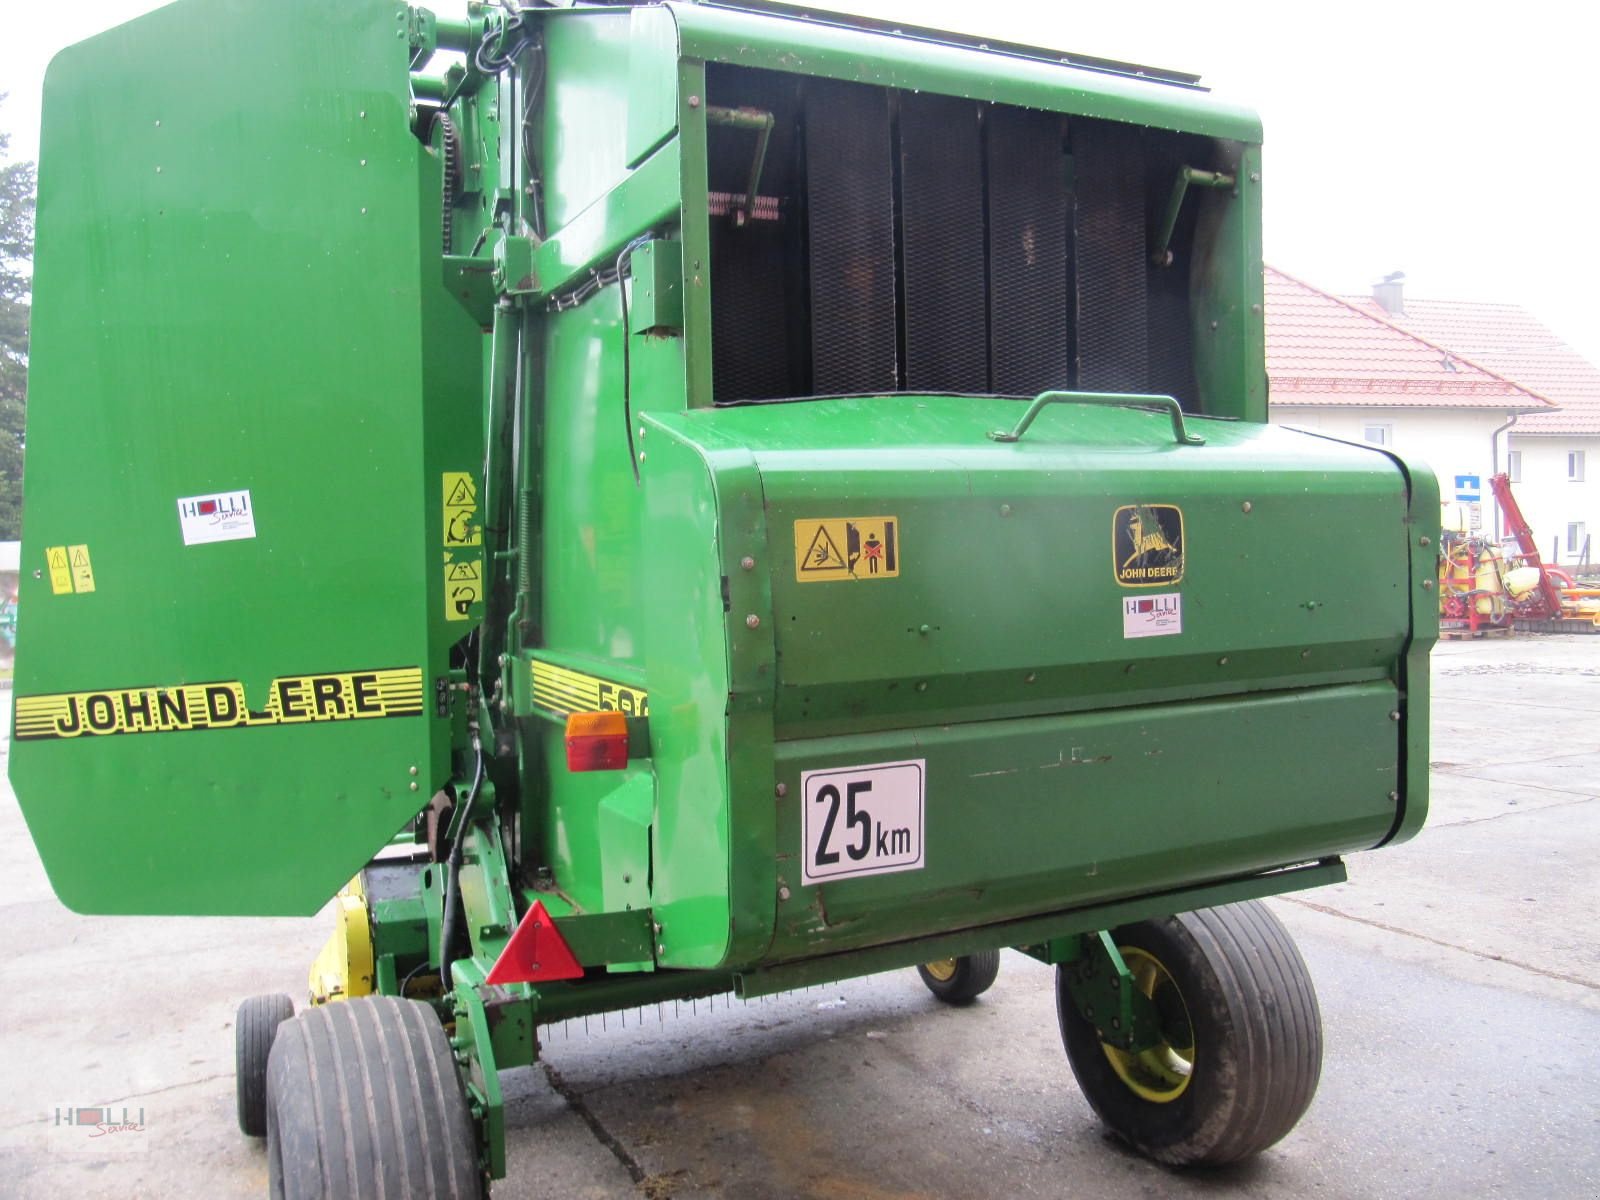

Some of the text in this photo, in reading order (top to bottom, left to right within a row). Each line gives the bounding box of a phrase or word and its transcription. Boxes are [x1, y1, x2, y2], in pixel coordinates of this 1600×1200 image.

[182, 495, 247, 518] HOLLI
[1120, 567, 1146, 579] JOHN
[1126, 597, 1177, 614] HOLLI
[55, 674, 383, 733] JOHN DERE
[815, 780, 911, 866] 25 km
